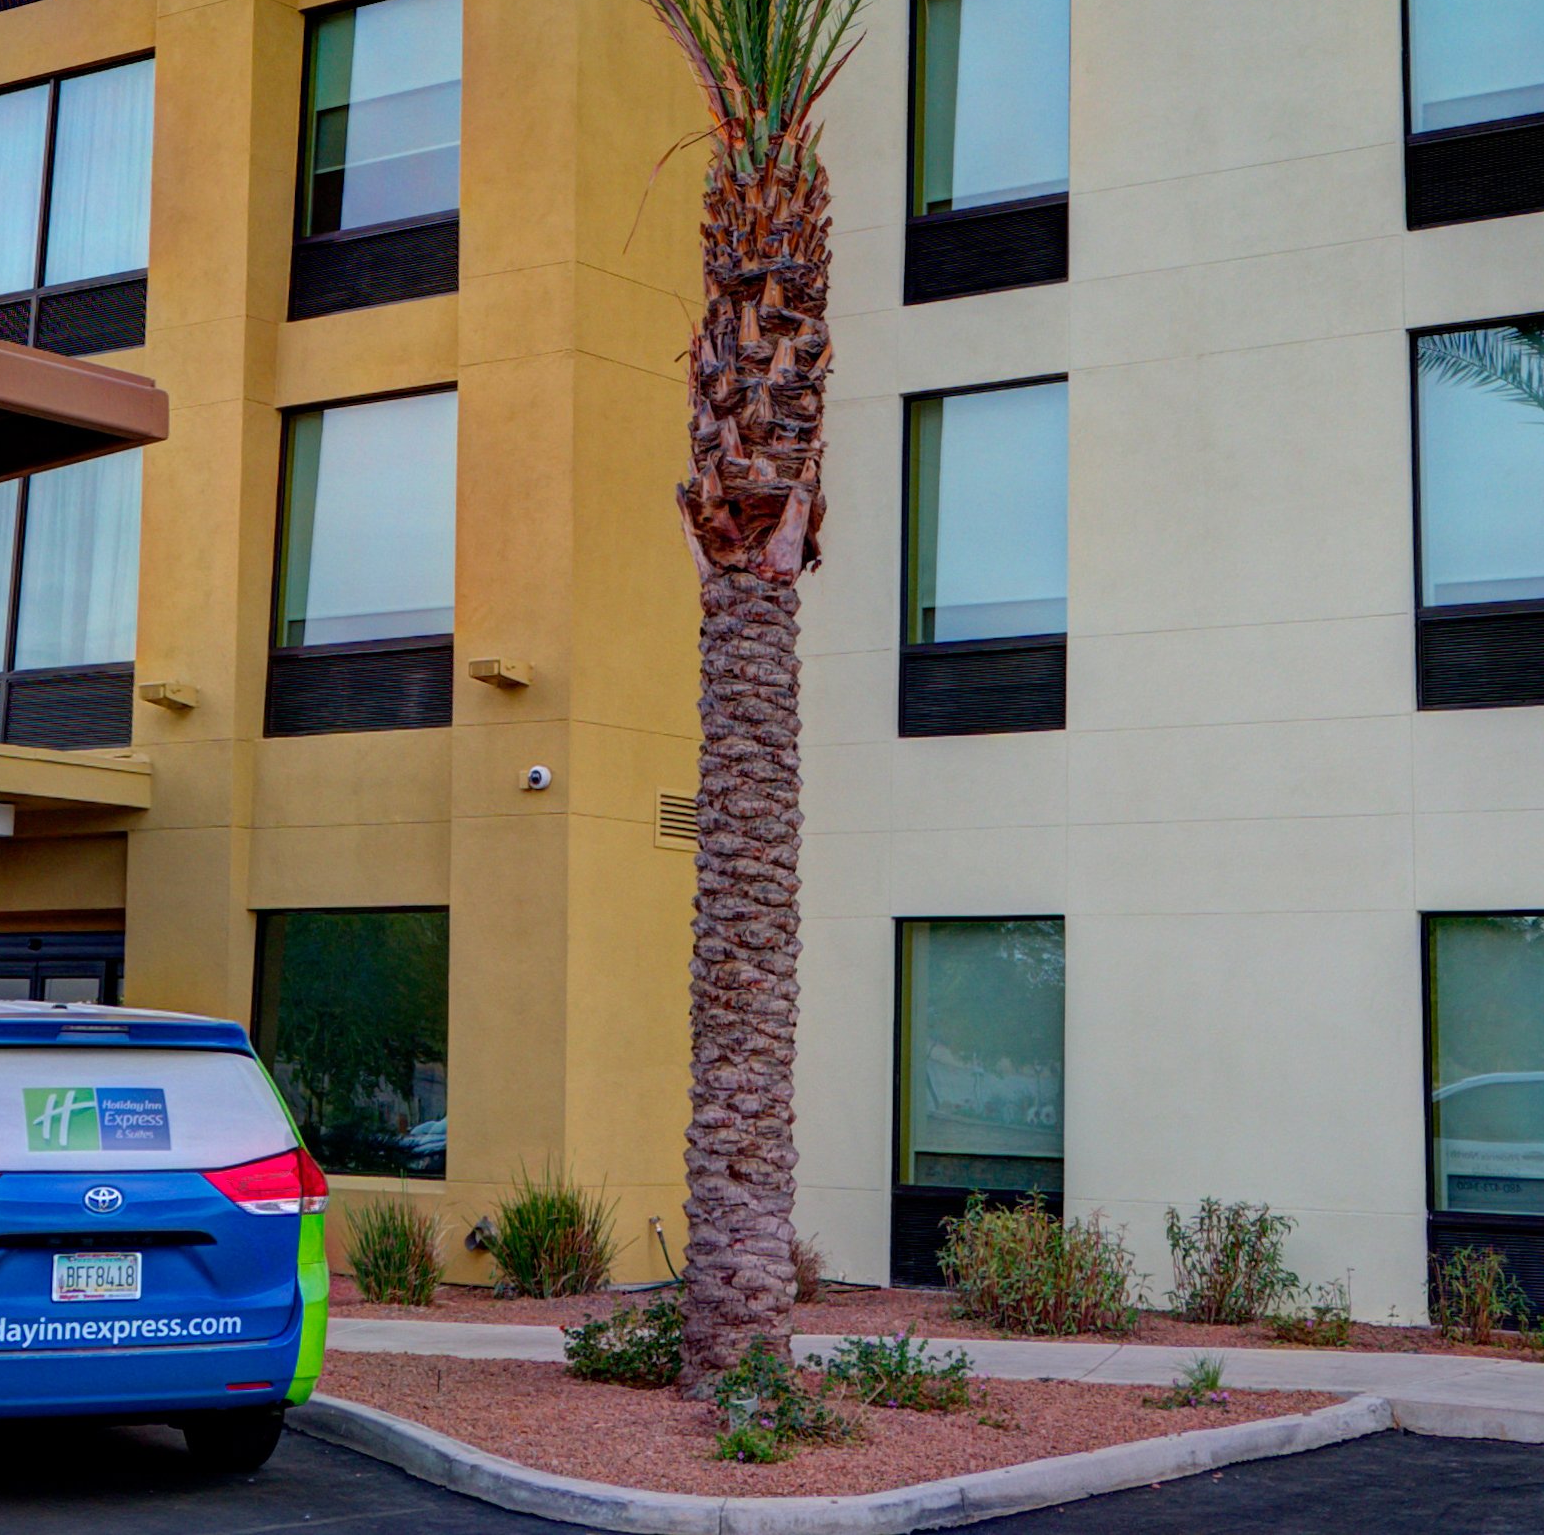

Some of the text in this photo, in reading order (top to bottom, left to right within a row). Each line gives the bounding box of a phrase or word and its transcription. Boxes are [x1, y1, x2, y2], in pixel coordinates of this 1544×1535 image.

[102, 1099, 162, 1112] Holiday Inn
[104, 1110, 164, 1129] Express
[125, 1129, 154, 1139] Suites
[65, 1265, 135, 1288] BFF8418
